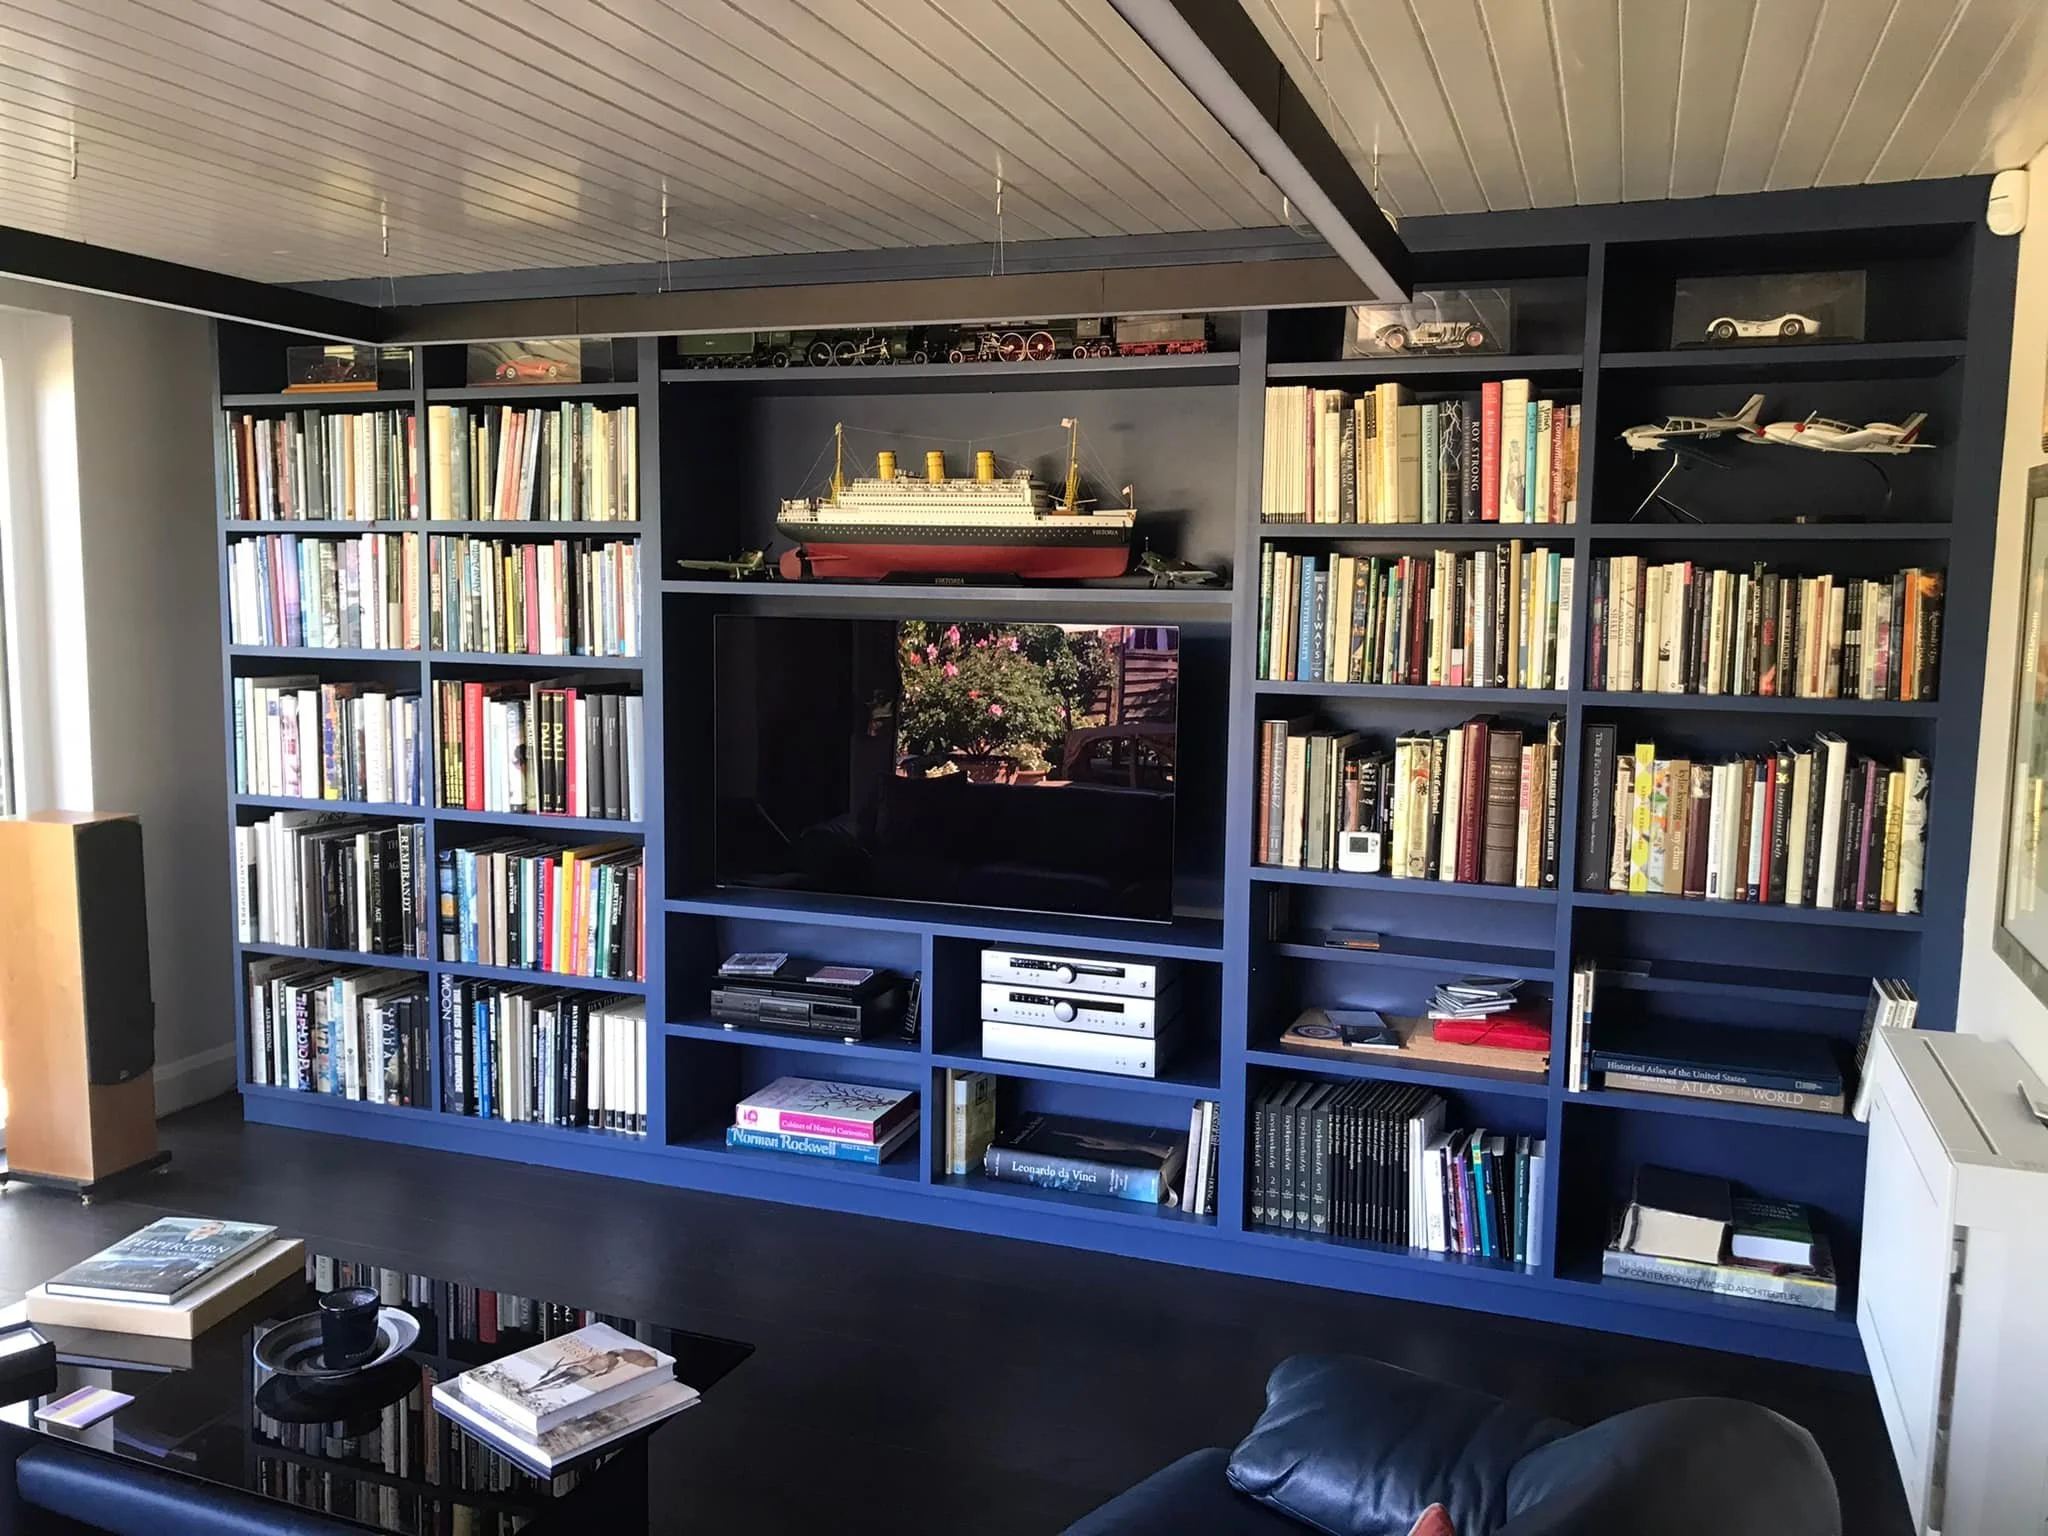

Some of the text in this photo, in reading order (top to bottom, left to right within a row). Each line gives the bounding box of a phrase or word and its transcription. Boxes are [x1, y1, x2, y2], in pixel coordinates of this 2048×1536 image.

[1346, 418, 1354, 435] THE
[1345, 440, 1354, 471] POWER
[1426, 449, 1433, 458] OF
[1471, 421, 1480, 491] ROY STRONG
[1551, 421, 1562, 495] companion guide
[1346, 474, 1354, 484] OF
[1560, 567, 1572, 611] DAVID HOCKNEY
[1301, 563, 1311, 661] TOYING WITH REALITY
[1313, 583, 1325, 659] RAILWAYS
[1610, 607, 1618, 640] SHAKER
[1594, 747, 1602, 757] Big
[1595, 733, 1603, 745] The
[1593, 770, 1601, 787] Duck
[1592, 787, 1600, 819] Cookbook
[1774, 788, 1785, 836] Inspirational
[1888, 803, 1900, 829] ART
[1672, 769, 1688, 871] kylie kwong my china
[1774, 838, 1784, 859] Chefs
[374, 871, 382, 904] GOLDEN
[400, 835, 412, 915] REMBRANDT
[241, 886, 249, 926] HOPPER
[375, 905, 383, 923] AGE
[536, 893, 544, 911] Lord
[536, 911, 544, 943] Leighton
[442, 973, 454, 1021] MOON
[453, 1004, 461, 1027] ATLAS
[297, 1018, 310, 1059] PHOTO
[383, 1011, 393, 1073] TODAY
[454, 1029, 461, 1039] OF
[454, 1041, 462, 1054] THE
[319, 1022, 330, 1081] ART BOOK
[455, 1055, 463, 1093] UNIVERSE
[1607, 1060, 1747, 1084] Historical Atlas of the United States
[1690, 1080, 1723, 1096] ATLAS
[1752, 1089, 1804, 1106] WORLD
[731, 1127, 778, 1148] Norman
[780, 1135, 836, 1156] Rockwell
[812, 1124, 836, 1135] Natural
[1011, 1160, 1097, 1183] Leonardo da Vinci
[125, 1237, 231, 1254] PEPPERCORN
[1618, 1267, 1803, 1303] OF CONTEMPORARY WORLD ARCHITECTURE
